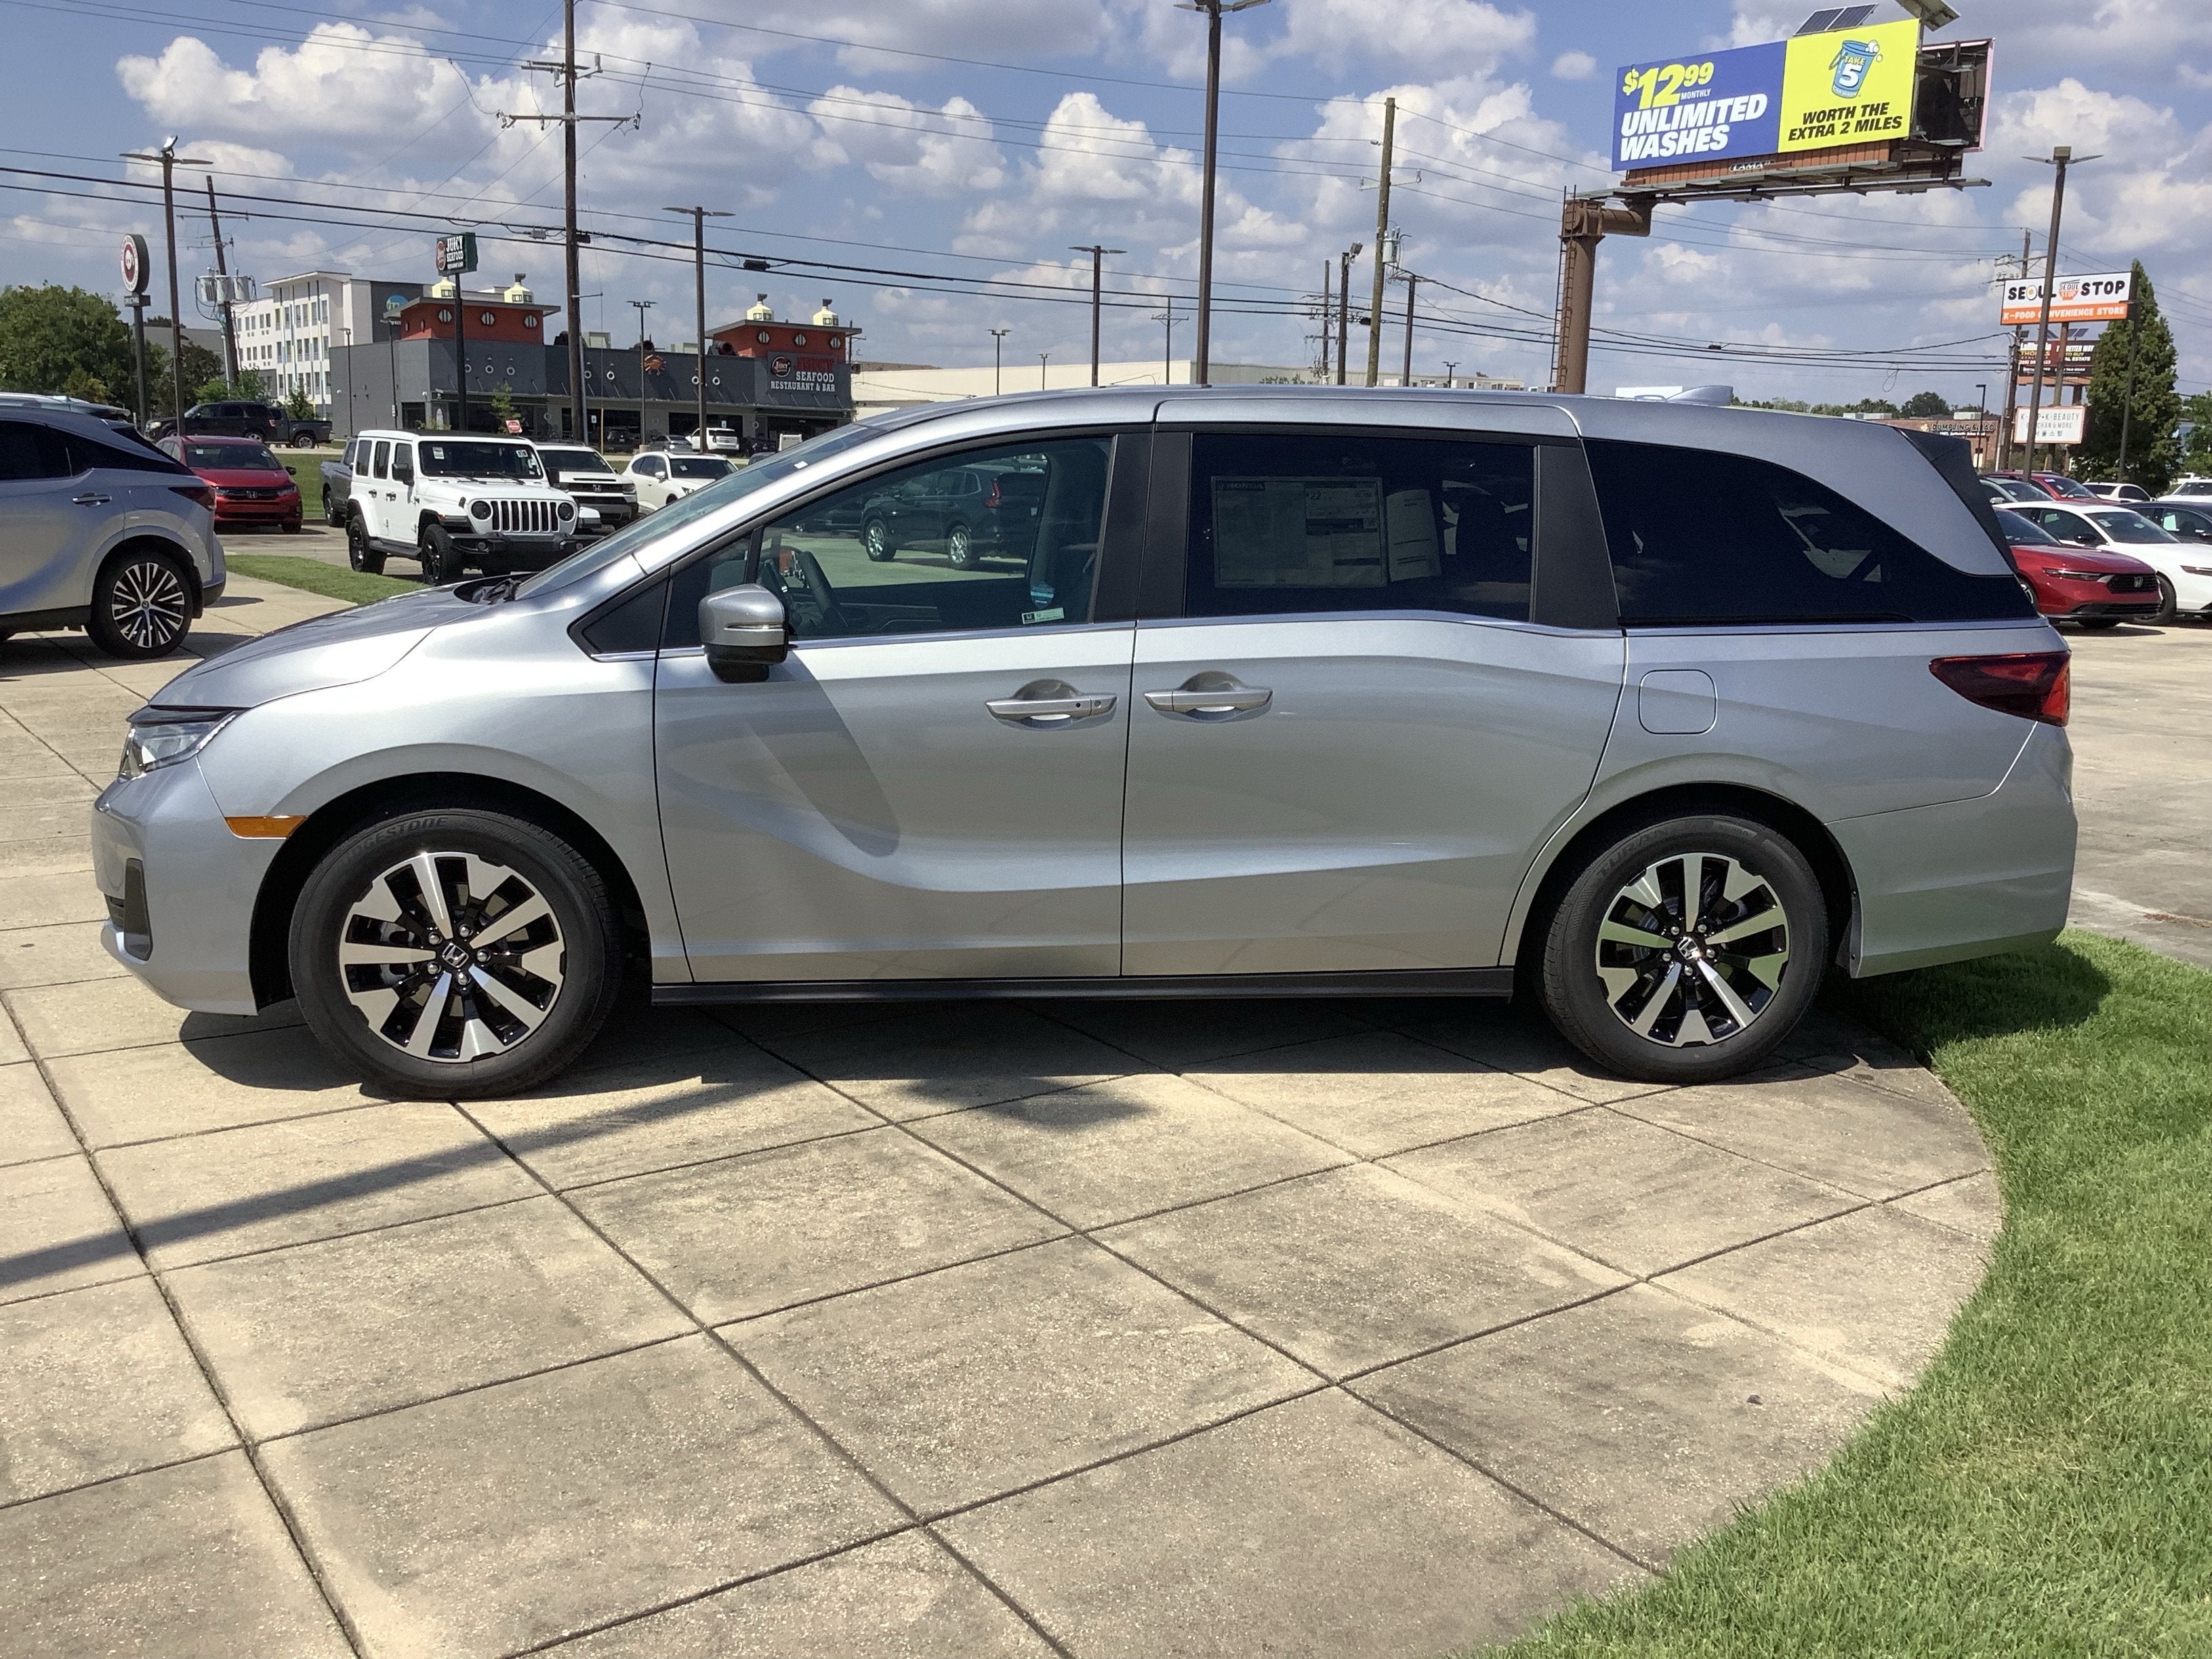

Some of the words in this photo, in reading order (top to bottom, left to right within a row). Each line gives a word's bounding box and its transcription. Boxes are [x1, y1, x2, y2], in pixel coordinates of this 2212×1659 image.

[1843, 56, 1866, 66] TAKE
[1839, 63, 1863, 87] 5
[1681, 88, 1712, 100] MONTHLY
[1620, 94, 1768, 137] UNLIMITED
[1803, 106, 1857, 125] WORTH
[1861, 102, 1890, 117] THE
[1788, 123, 1835, 142] EXTRA
[1840, 121, 1850, 135] 2
[1854, 116, 1903, 133] MILES
[1620, 124, 1730, 161] WASHES
[446, 235, 463, 253] JUICY
[2081, 281, 2125, 296] STOP
[2003, 310, 2036, 321] K-FOOD
[2038, 308, 2094, 319] CNVENIENCE
[2096, 306, 2125, 316] STORE
[796, 371, 834, 383] SEAFOOD
[771, 381, 814, 391] RESTAURANT
[815, 383, 821, 391] &
[822, 384, 836, 392] BAR
[1932, 424, 1971, 432] DUMPLING
[1971, 424, 1979, 432] &
